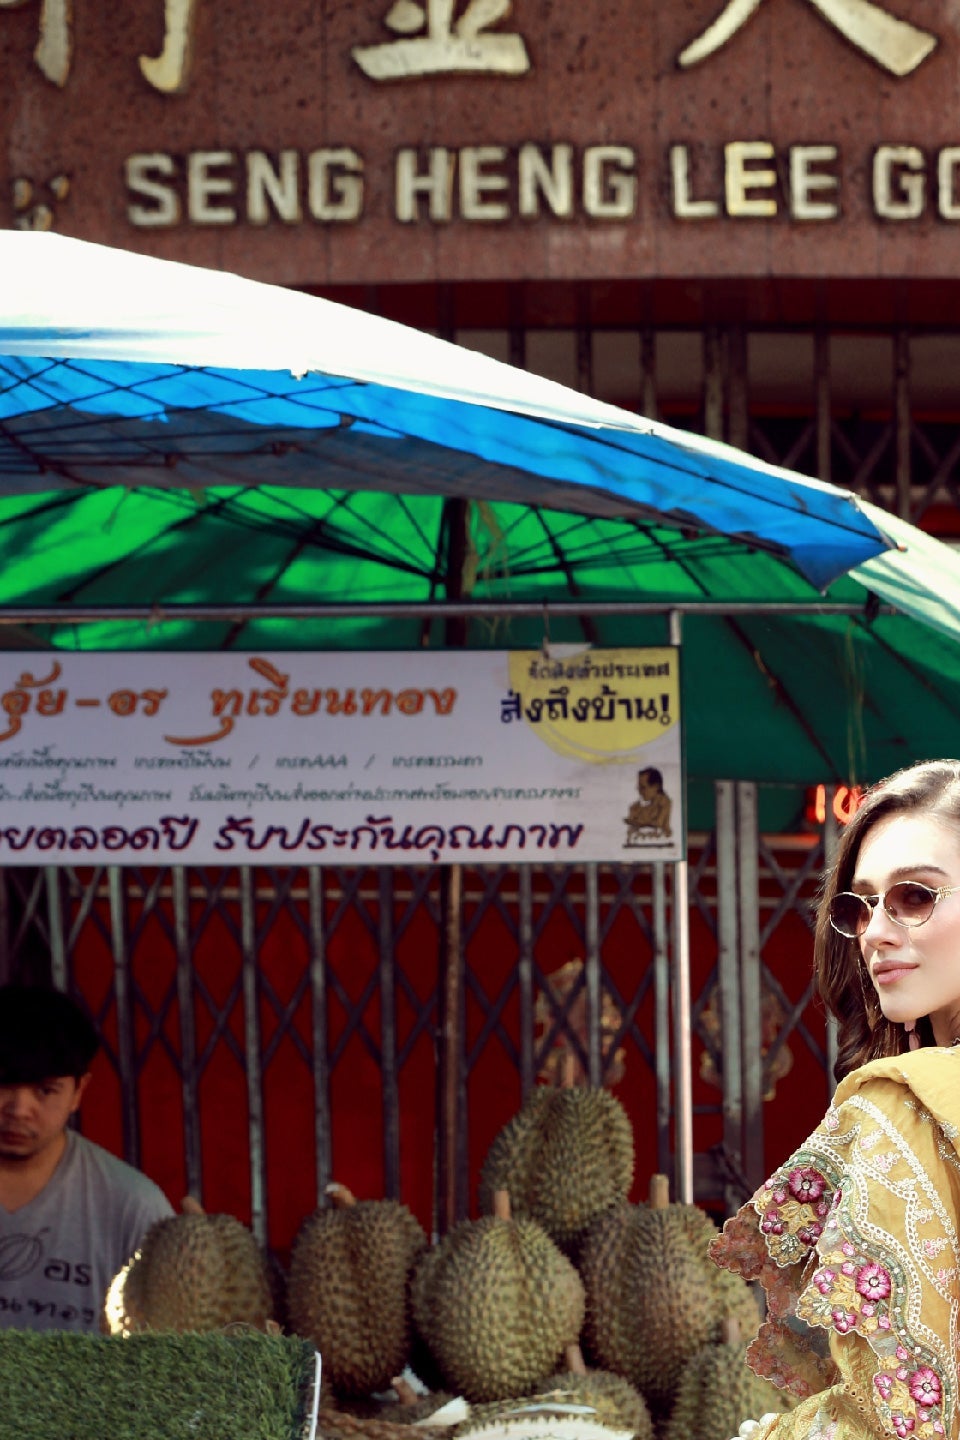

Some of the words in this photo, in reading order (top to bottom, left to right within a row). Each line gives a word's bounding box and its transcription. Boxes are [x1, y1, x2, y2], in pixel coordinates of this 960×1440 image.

[125, 149, 364, 227] SENG
[396, 144, 637, 222] HENG
[670, 141, 839, 221] LEE
[163, 656, 457, 746] ทุเรียนทอง
[500, 684, 672, 726] ส่งถึงบ้าน!
[213, 815, 585, 862] รับประกันคุณภาพ
